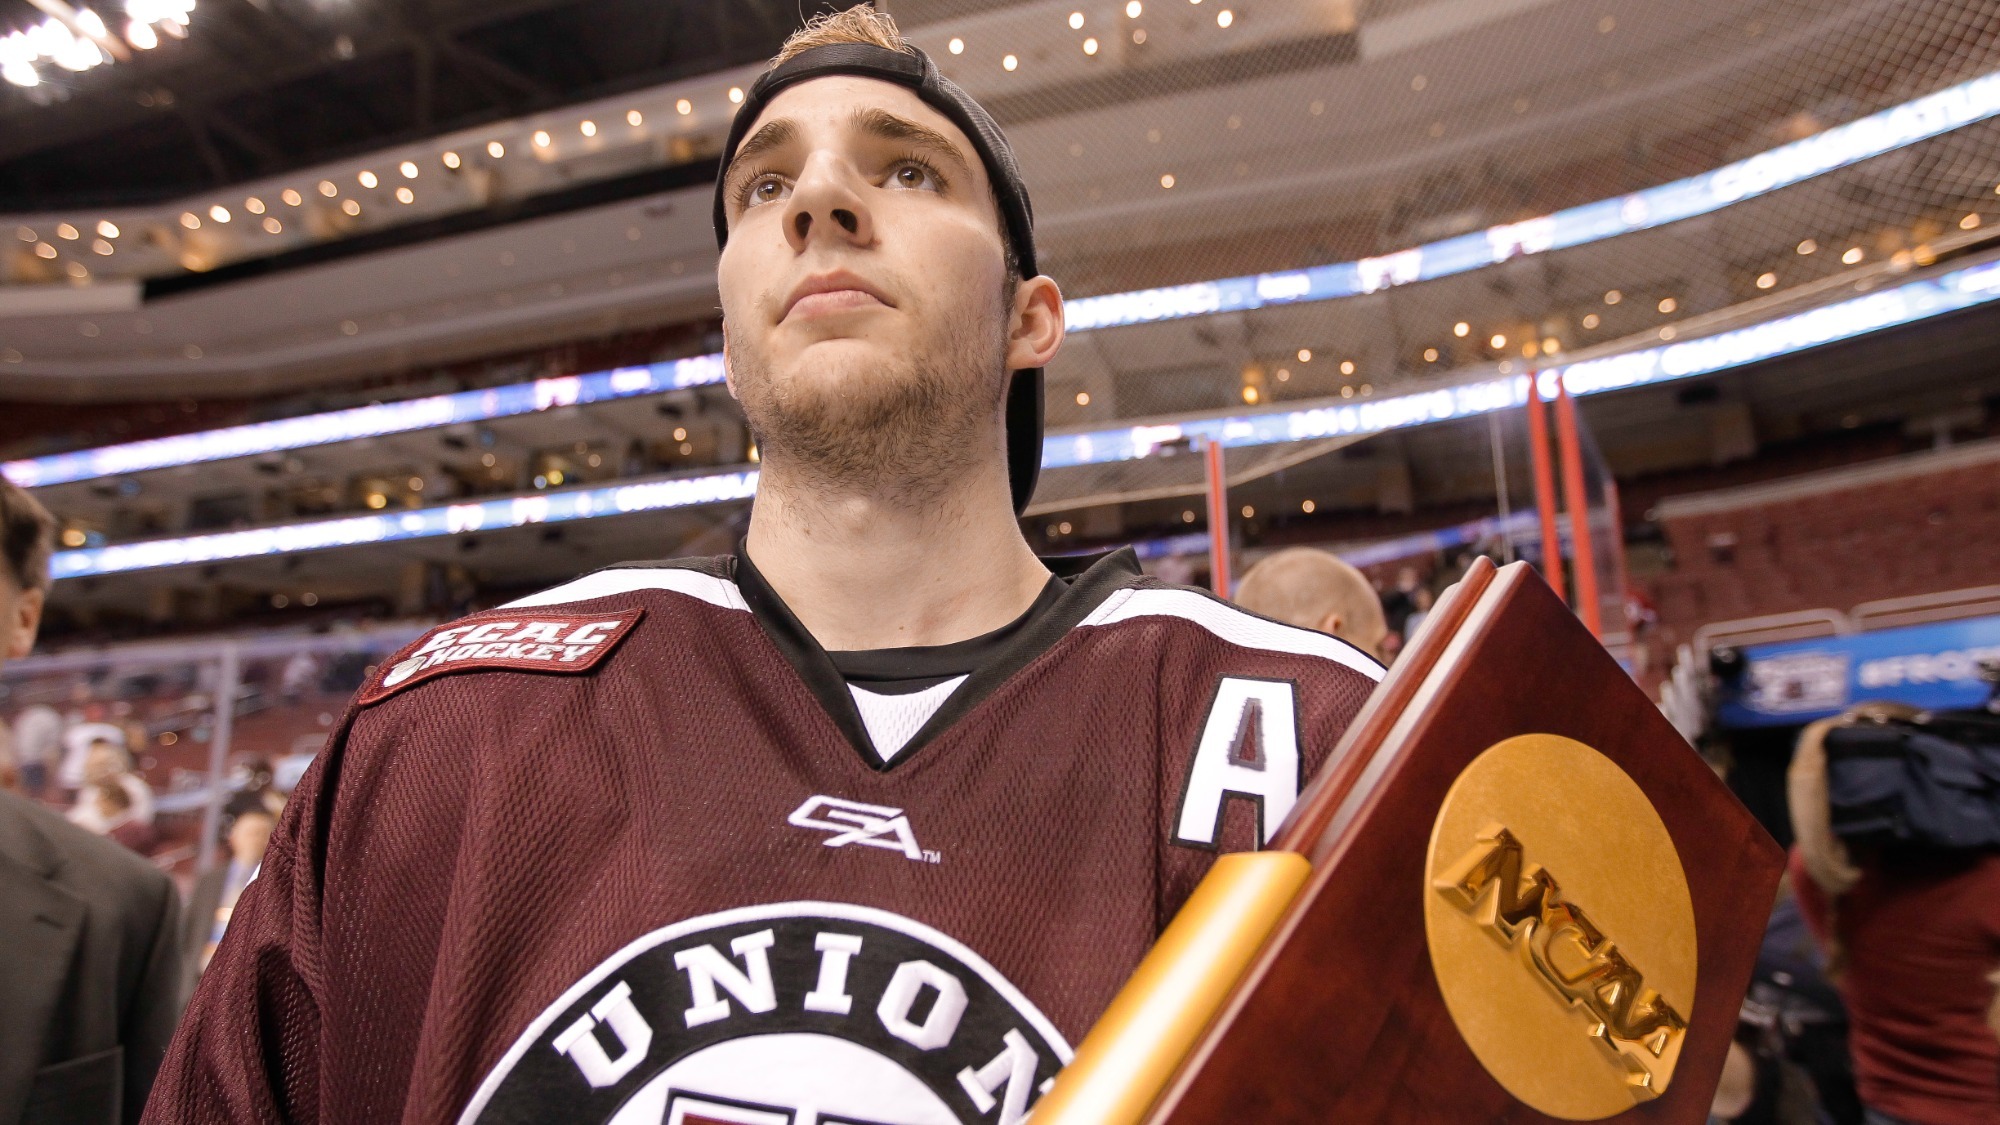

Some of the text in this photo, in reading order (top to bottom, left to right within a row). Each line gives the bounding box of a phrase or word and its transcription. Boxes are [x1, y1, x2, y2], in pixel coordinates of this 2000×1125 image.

[412, 620, 623, 656] ECAC
[420, 642, 597, 671] HOCKEY
[1170, 672, 1301, 852] A
[1433, 821, 1687, 1099] NCAA
